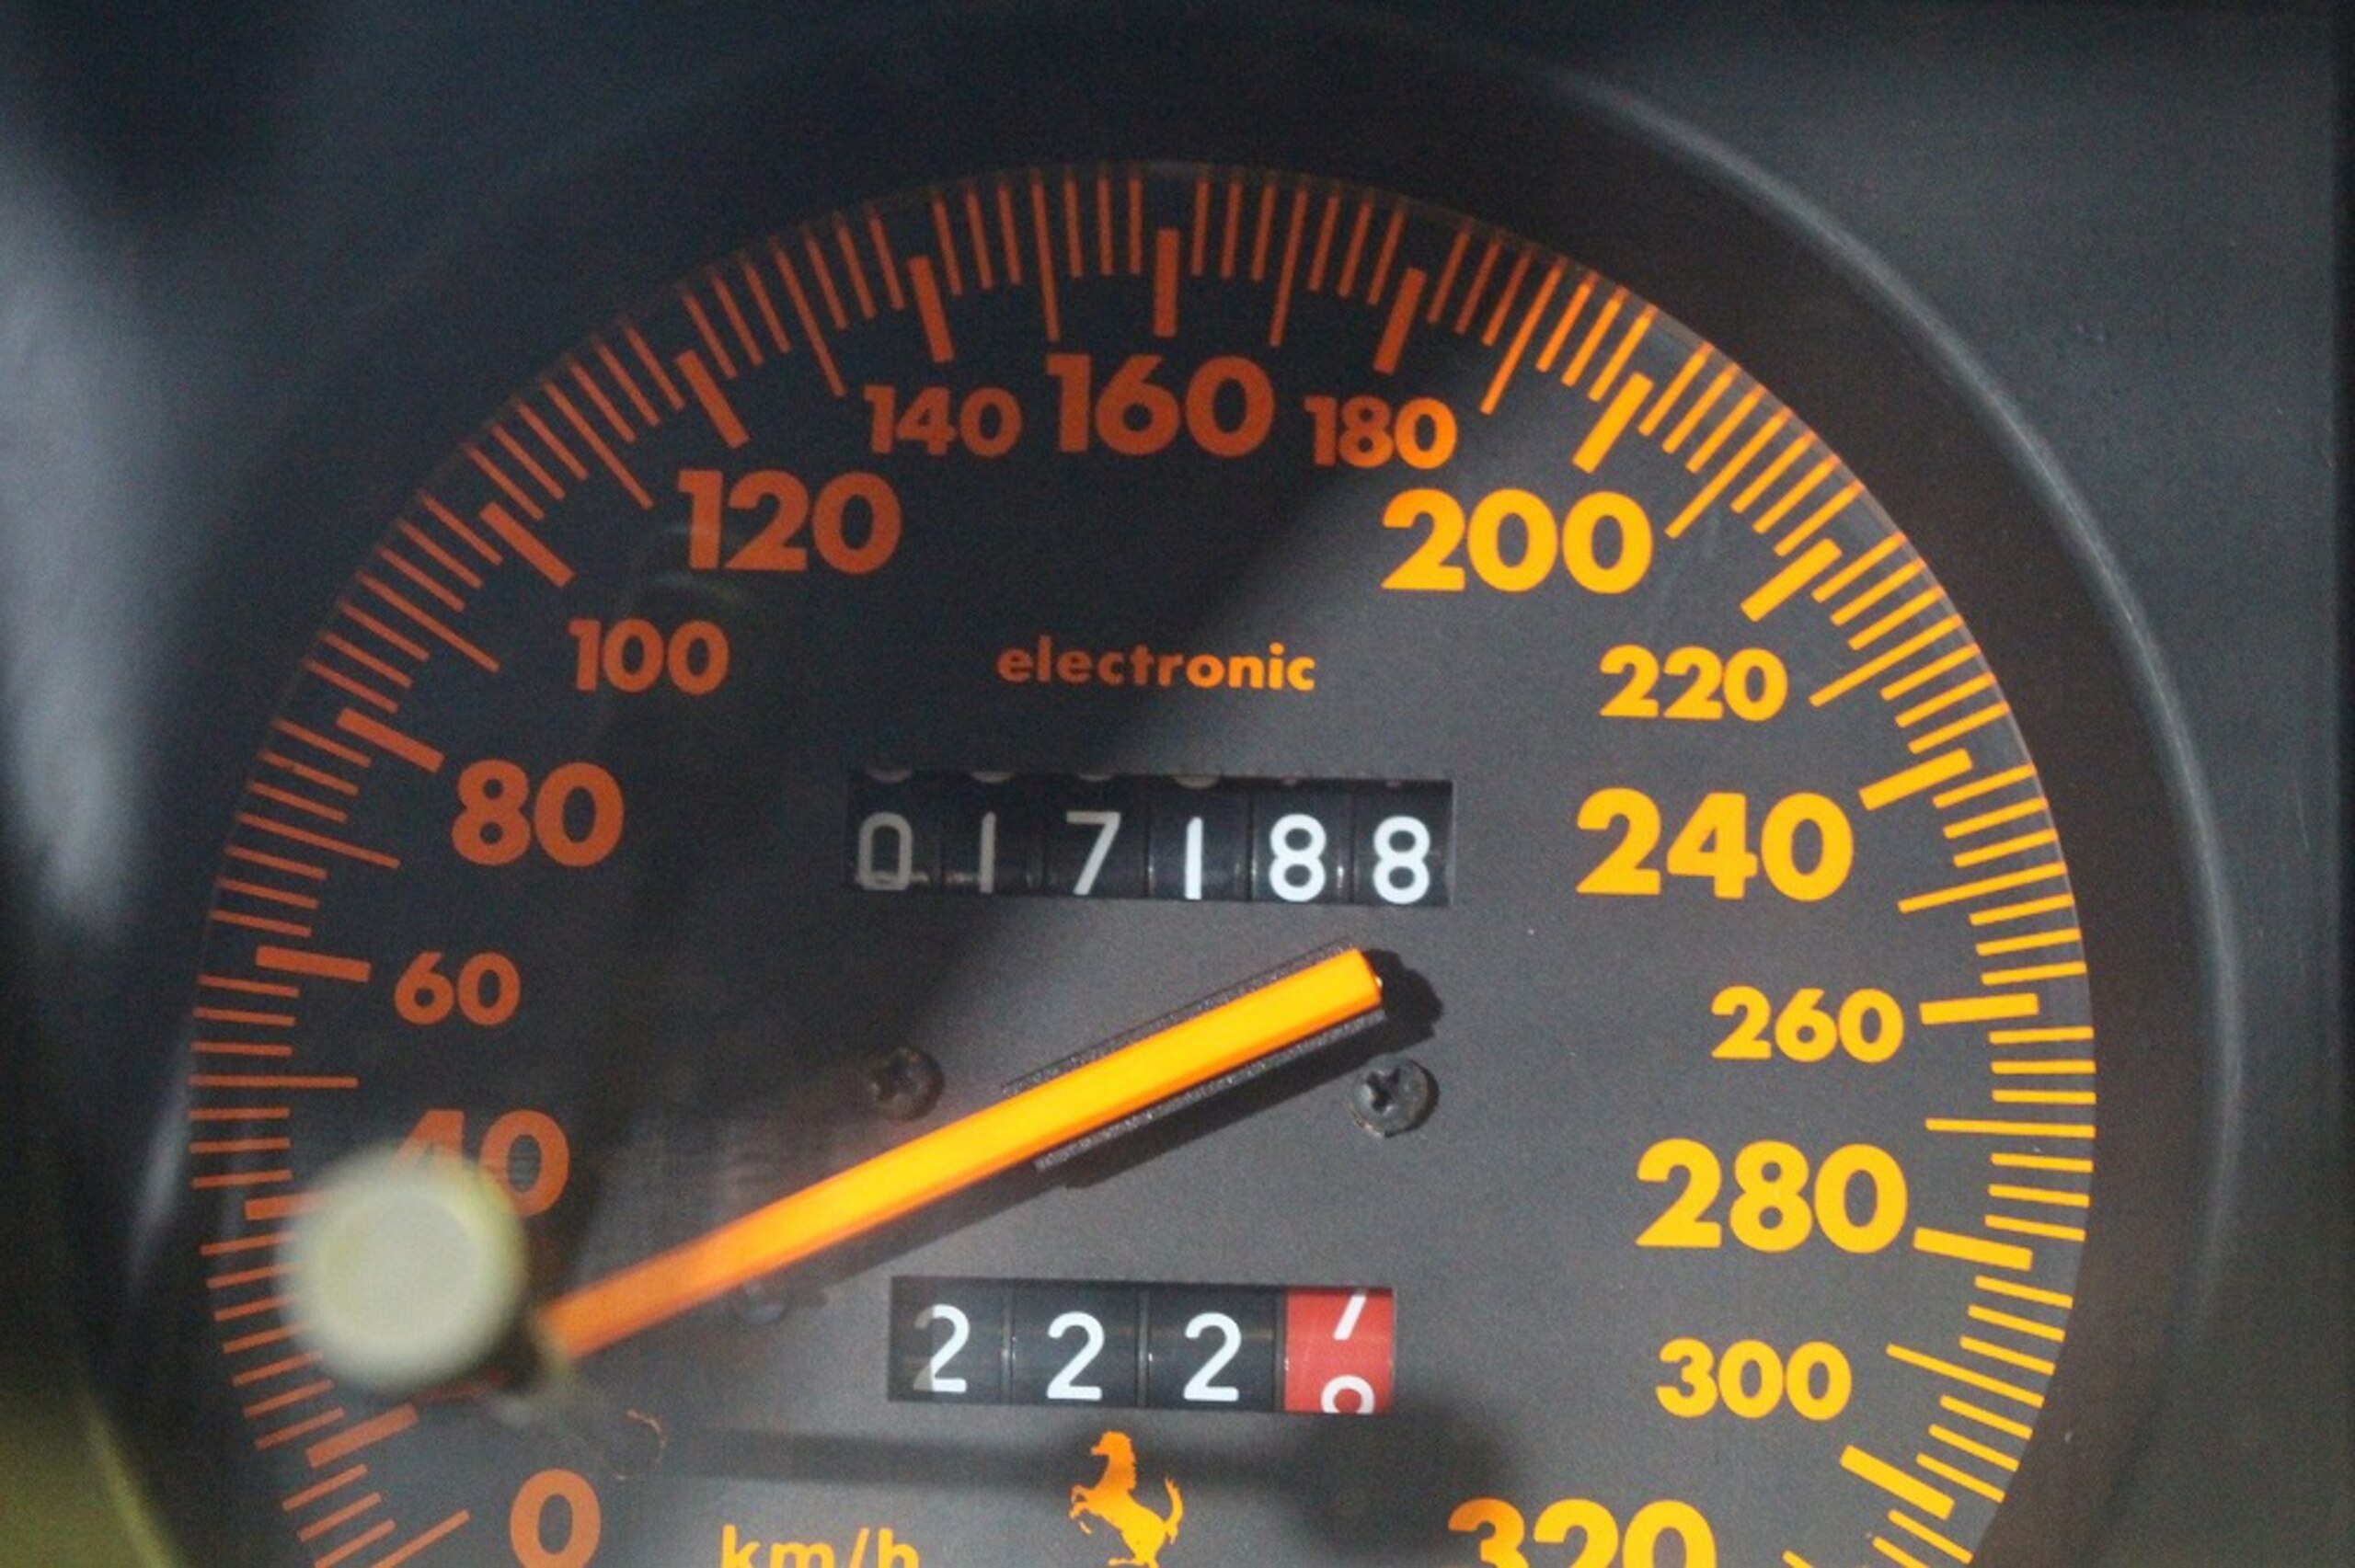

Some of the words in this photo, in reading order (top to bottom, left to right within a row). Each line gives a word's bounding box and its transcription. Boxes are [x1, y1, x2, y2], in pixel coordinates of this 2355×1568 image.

[866, 387, 1020, 456] 140
[1048, 355, 1274, 456] 160
[1305, 396, 1458, 471] 180
[679, 471, 899, 573] 120
[1381, 487, 1655, 595] 200
[570, 619, 729, 694] 100
[998, 639, 1315, 692] electronic
[1599, 644, 1789, 722] 220
[453, 760, 623, 865] 80
[1576, 785, 1855, 903] 240
[857, 810, 1430, 904] 017188
[395, 952, 519, 1027] 60
[1709, 983, 1905, 1065] 260
[1635, 1138, 1909, 1254] 280
[1656, 1336, 1853, 1423] 300
[511, 1470, 600, 1568] 0
[1448, 1496, 1717, 1568] 320
